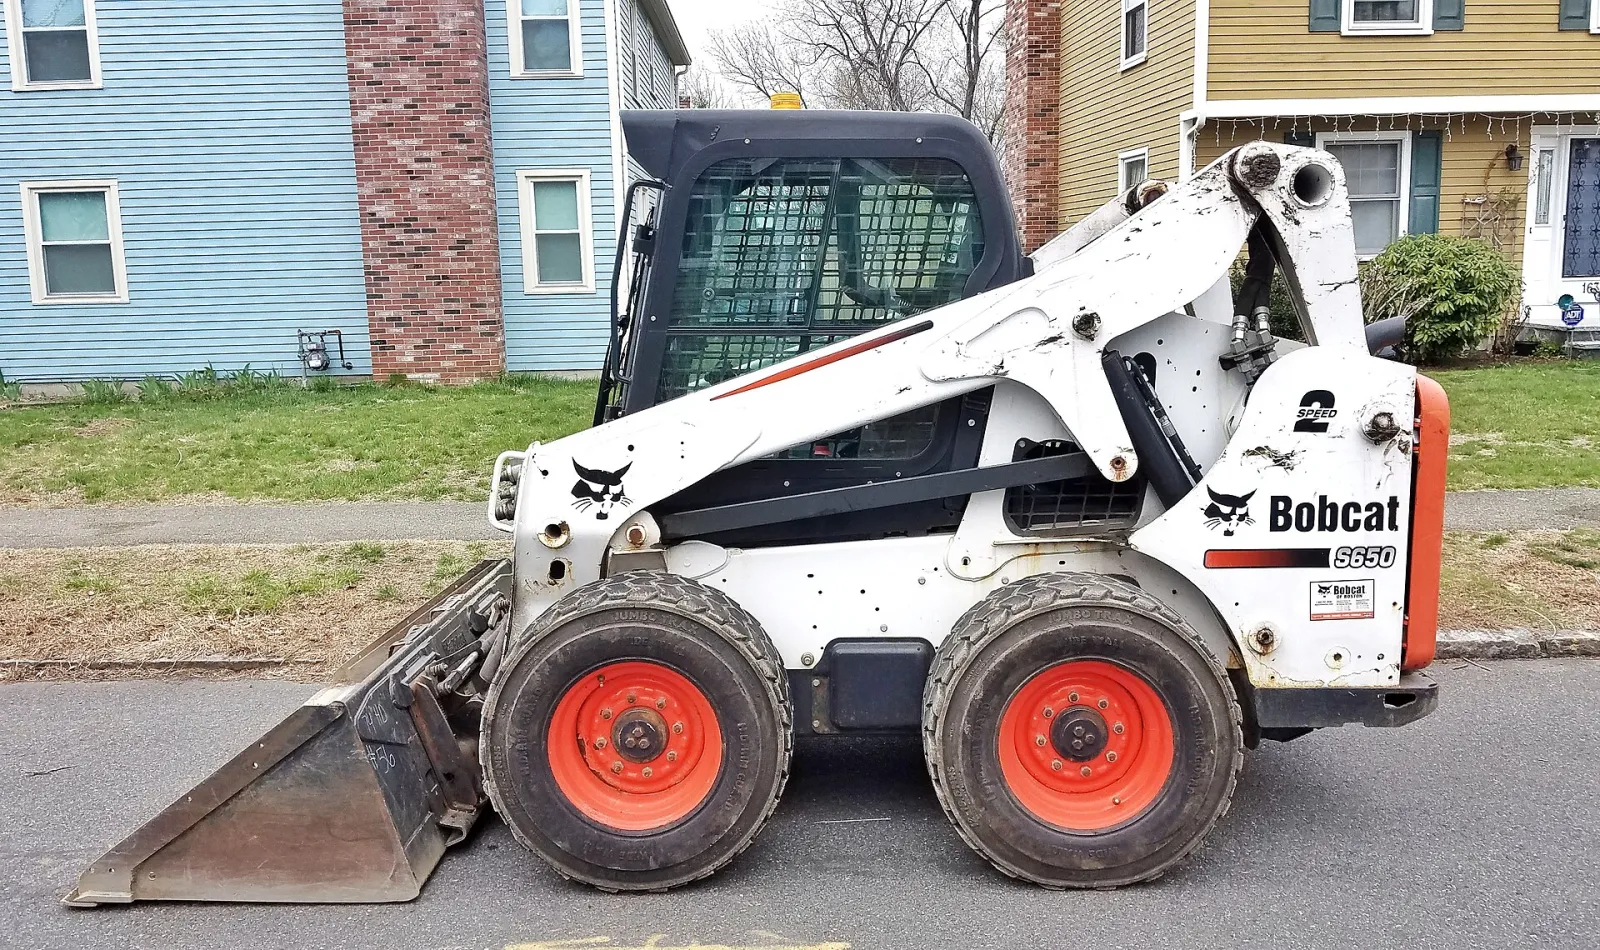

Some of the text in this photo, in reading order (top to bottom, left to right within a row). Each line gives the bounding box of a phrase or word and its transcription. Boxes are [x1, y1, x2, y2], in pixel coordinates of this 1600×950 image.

[1566, 311, 1580, 319] ADT
[1293, 389, 1335, 433] 2
[1296, 408, 1338, 418] SPEED
[1269, 494, 1400, 532] Bobcat
[1334, 545, 1397, 569] S650
[1334, 585, 1365, 595] Bobcat
[365, 743, 396, 774] #56
